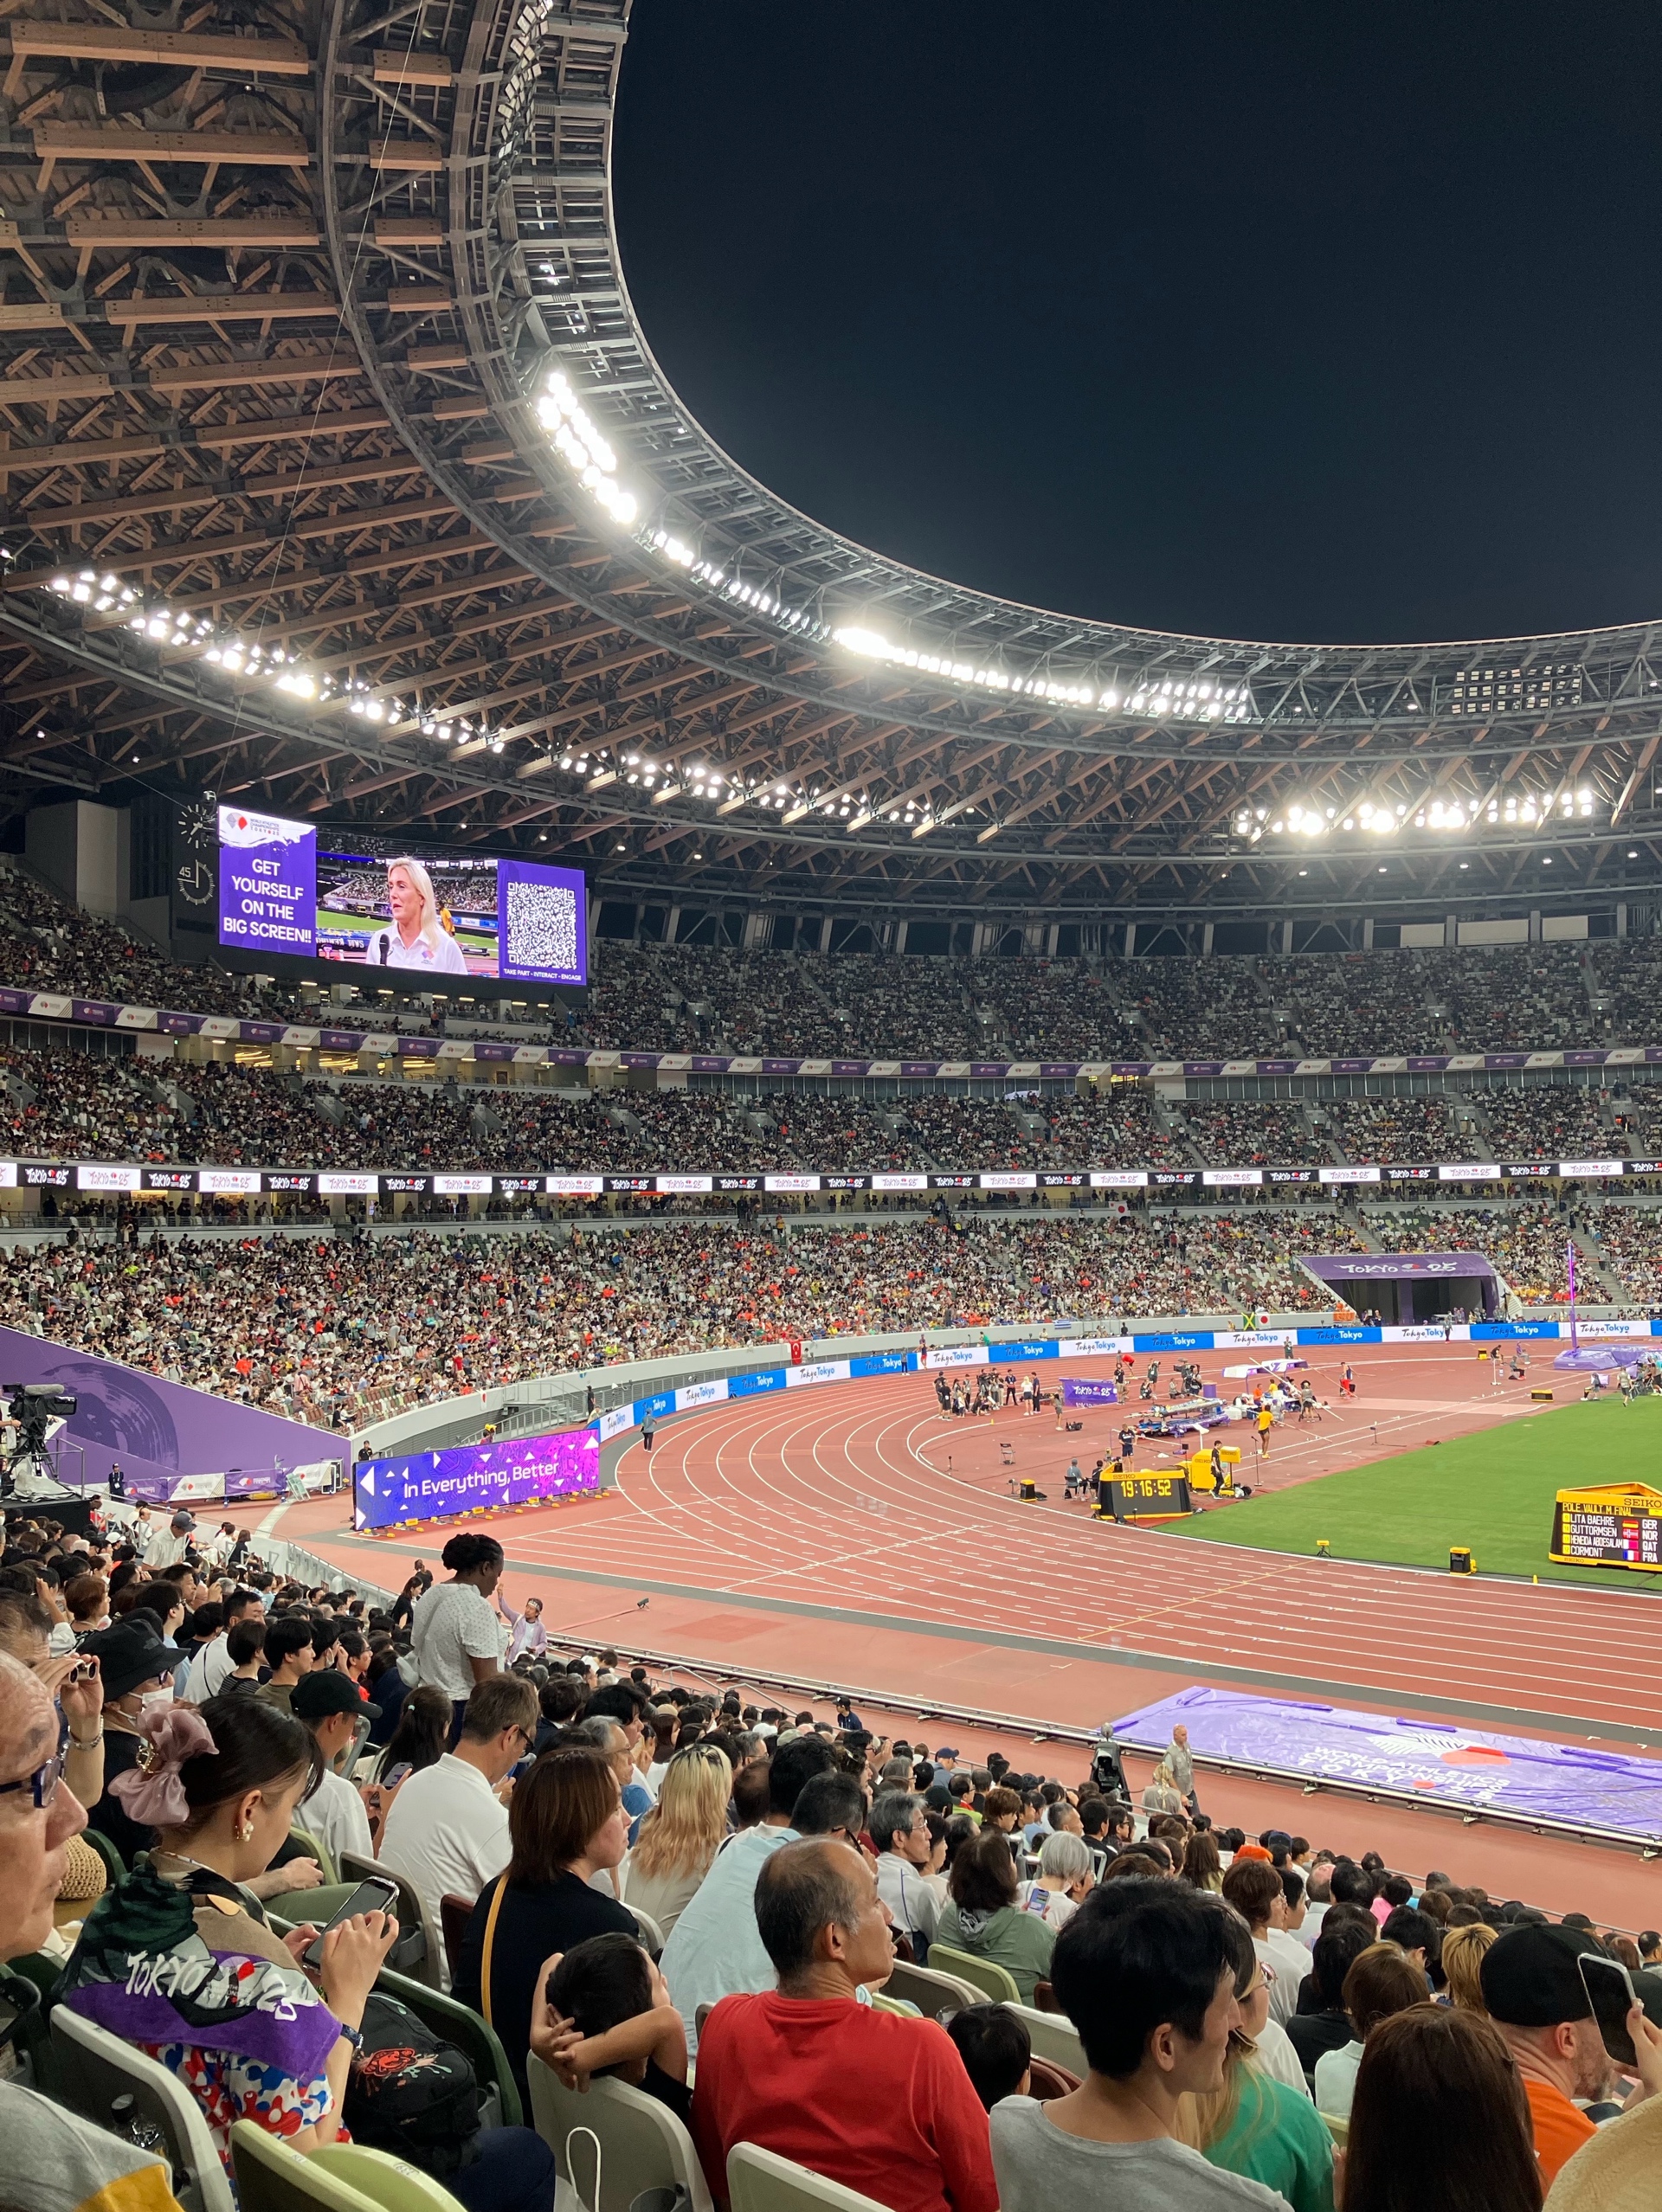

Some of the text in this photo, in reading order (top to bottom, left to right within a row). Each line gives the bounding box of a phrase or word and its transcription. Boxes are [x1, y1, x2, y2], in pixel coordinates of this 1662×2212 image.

[179, 866, 190, 878] 45
[252, 858, 280, 876] GET
[231, 875, 304, 901] YOURSELF
[242, 898, 294, 921] ON THE
[223, 916, 312, 943] BIG SCREEN!!
[1388, 1168, 1431, 1179] TOKYO 25
[1449, 1168, 1492, 1178] TOKYO 25
[1508, 1166, 1552, 1176] TOKYO 25
[1569, 1165, 1613, 1174] TOKYO 25
[1631, 1163, 1653, 1173] TOKYO
[25, 1168, 69, 1185] TOKYO 25
[88, 1171, 130, 1186] TOKYO 25
[148, 1173, 192, 1188] TOKYO 25
[1042, 1175, 1083, 1186] TOKYO 25
[1099, 1175, 1139, 1184] TOKYO 25
[1155, 1174, 1195, 1184] TOKYO 25
[1213, 1173, 1253, 1182] TOKYO 25
[1269, 1172, 1311, 1182] TOKYO 25
[1329, 1170, 1370, 1180] TOKYO 25
[209, 1174, 252, 1189] TOKYO 25
[268, 1176, 312, 1190] TOKYO 25
[328, 1178, 369, 1190] TOKYO 25
[385, 1179, 427, 1191] TOKYO 25
[443, 1180, 483, 1190] TOKYO 25
[499, 1180, 539, 1191] TOKYO 25
[556, 1180, 595, 1190] TOKYO 25
[610, 1179, 650, 1190] TOKYO 25
[666, 1180, 704, 1190] TOKYO 25
[719, 1179, 758, 1189] TOKYO 25
[774, 1179, 811, 1188] TOKYO 25
[827, 1178, 866, 1188] TOKYO 25
[882, 1178, 918, 1187] TOKYO 25
[934, 1176, 973, 1187] TOKYO 25
[989, 1176, 1027, 1186] TOKYO 25
[1333, 1264, 1399, 1274] TOKYO
[1427, 1261, 1459, 1272] 25
[1425, 1328, 1444, 1338] Toky
[1513, 1325, 1539, 1336] Tokyo
[1604, 1323, 1630, 1334] Tokyo
[1255, 1334, 1279, 1343] Tokyo
[1338, 1330, 1363, 1341] Tokyo
[1094, 1341, 1116, 1351] Tokyo
[1172, 1336, 1196, 1347] Tokyo
[951, 1351, 973, 1361] Tokyo
[1023, 1345, 1044, 1356] Tokyo
[882, 1358, 902, 1369] Tokyo
[816, 1366, 835, 1378] Tokyo
[756, 1375, 774, 1388] Tokyo
[699, 1386, 715, 1399] Tokyo
[1073, 1386, 1092, 1395] TOKYO
[1100, 1387, 1111, 1397] 25
[652, 1399, 667, 1412] Tokyo
[615, 1413, 626, 1425] Tokyo
[404, 1462, 559, 1499] In Everything, Better
[1121, 1479, 1171, 1498] 19:16:52
[1624, 1498, 1662, 1508] SEIKO
[1562, 1502, 1634, 1517] POLE VAULT M FINAL
[1570, 1513, 1586, 1524] LITA
[1587, 1514, 1615, 1527] BAEHRE
[1642, 1519, 1658, 1530] GER
[1570, 1525, 1618, 1538] GUTTORMSEN
[1642, 1530, 1659, 1541] NOR
[1642, 1540, 1658, 1553] QAT
[1570, 1545, 1604, 1558] CORMONT
[1642, 1552, 1659, 1563] FRA
[1314, 1746, 1511, 1786] WORLD ATHLETICS
[1304, 1752, 1504, 1795] CHAMPIONSHIPS
[1444, 1785, 1497, 1800] 25
[126, 1950, 217, 1998] TOKYO
